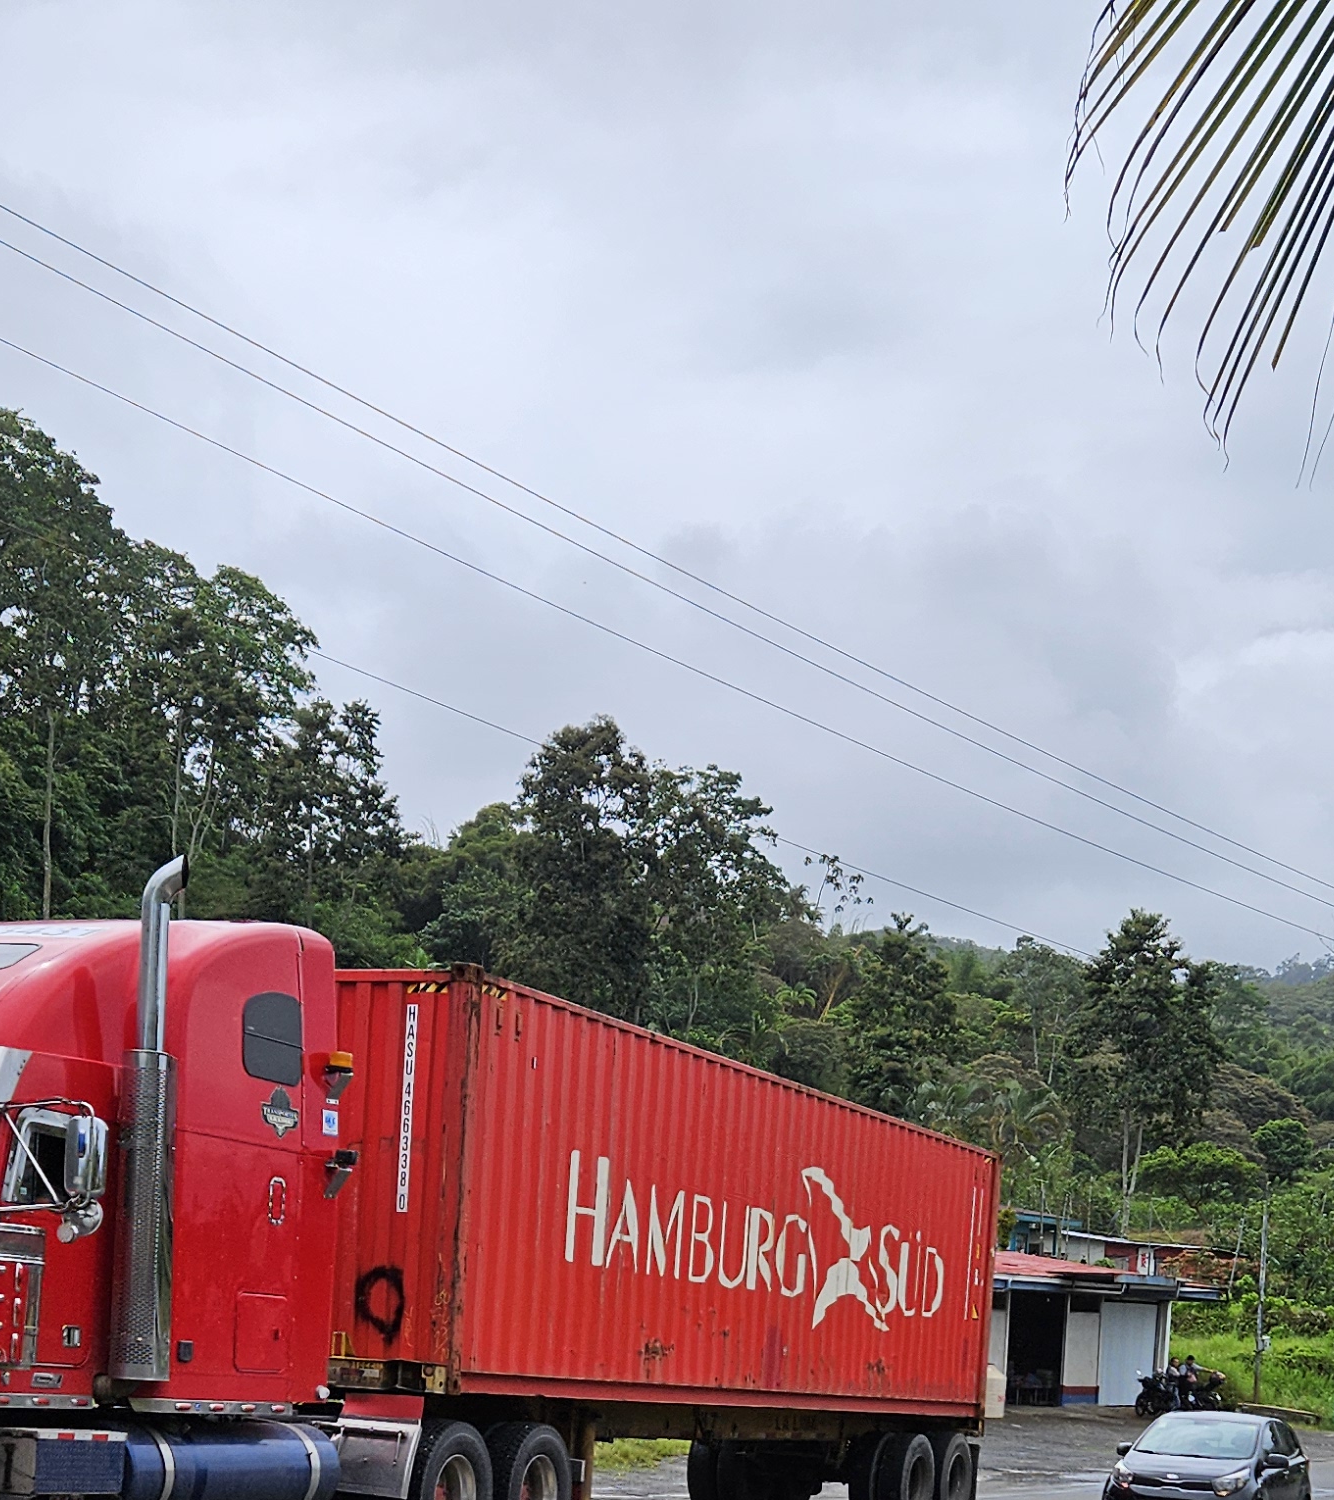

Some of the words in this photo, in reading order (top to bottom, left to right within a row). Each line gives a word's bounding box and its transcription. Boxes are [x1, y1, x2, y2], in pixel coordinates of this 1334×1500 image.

[405, 1005, 416, 1076] HASU
[399, 1082, 412, 1187] 466338
[398, 1193, 406, 1210] 0
[564, 1149, 808, 1298] HAMBURG
